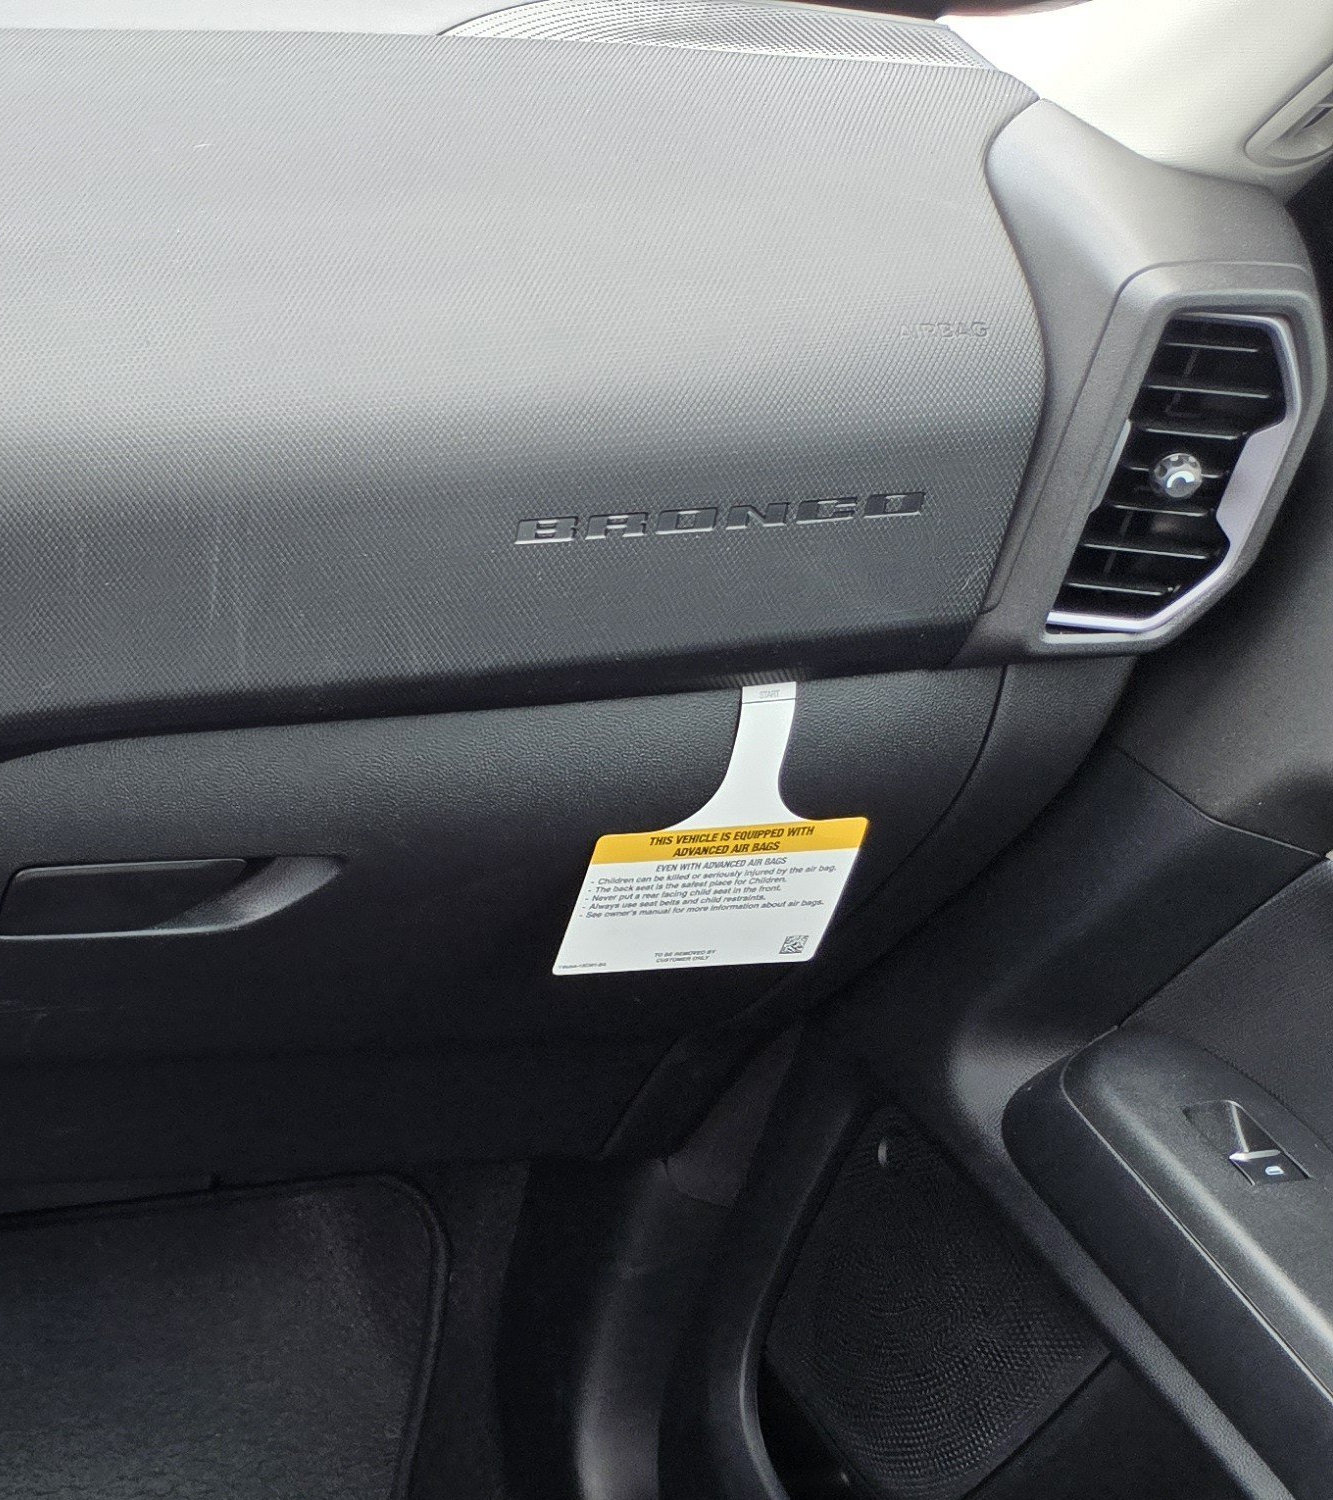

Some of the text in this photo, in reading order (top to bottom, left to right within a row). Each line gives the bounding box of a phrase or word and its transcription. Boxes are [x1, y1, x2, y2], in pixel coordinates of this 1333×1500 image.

[514, 491, 926, 545] BRONCO
[650, 826, 816, 846] THIS VEHICLE IS EQUIPPED WITH
[673, 841, 781, 857] ADVANCED AIR BAGS
[656, 856, 788, 873] EVEN WITH ADVANCED AIR BAGS
[598, 876, 633, 886] Children
[654, 874, 664, 882] be
[666, 873, 690, 881] killed
[703, 870, 741, 880] seriously
[744, 868, 775, 878] injured
[776, 867, 788, 876] by
[789, 866, 803, 874] the
[805, 865, 817, 873] air
[818, 865, 837, 873] bag.
[592, 893, 619, 902] Never
[620, 892, 633, 902] put
[642, 891, 659, 899] rear
[661, 889, 687, 899] facing
[689, 888, 711, 897] child
[713, 887, 731, 895] seat
[743, 885, 757, 893] the
[595, 885, 611, 894] The
[615, 884, 633, 893] back
[635, 883, 654, 891] seat
[665, 882, 678, 890] the
[680, 880, 707, 889] safest
[709, 879, 732, 888] place
[734, 877, 747, 886] for
[585, 911, 602, 919] See
[604, 909, 637, 918] owner's
[639, 907, 671, 916] manual
[672, 905, 684, 914] for
[710, 902, 760, 911] information
[761, 900, 786, 909] about
[787, 899, 800, 907] air
[589, 902, 619, 911] Always
[621, 901, 638, 909] use
[639, 900, 658, 908] seat
[659, 898, 680, 907] belts
[682, 897, 698, 905] and
[700, 896, 721, 904] child
